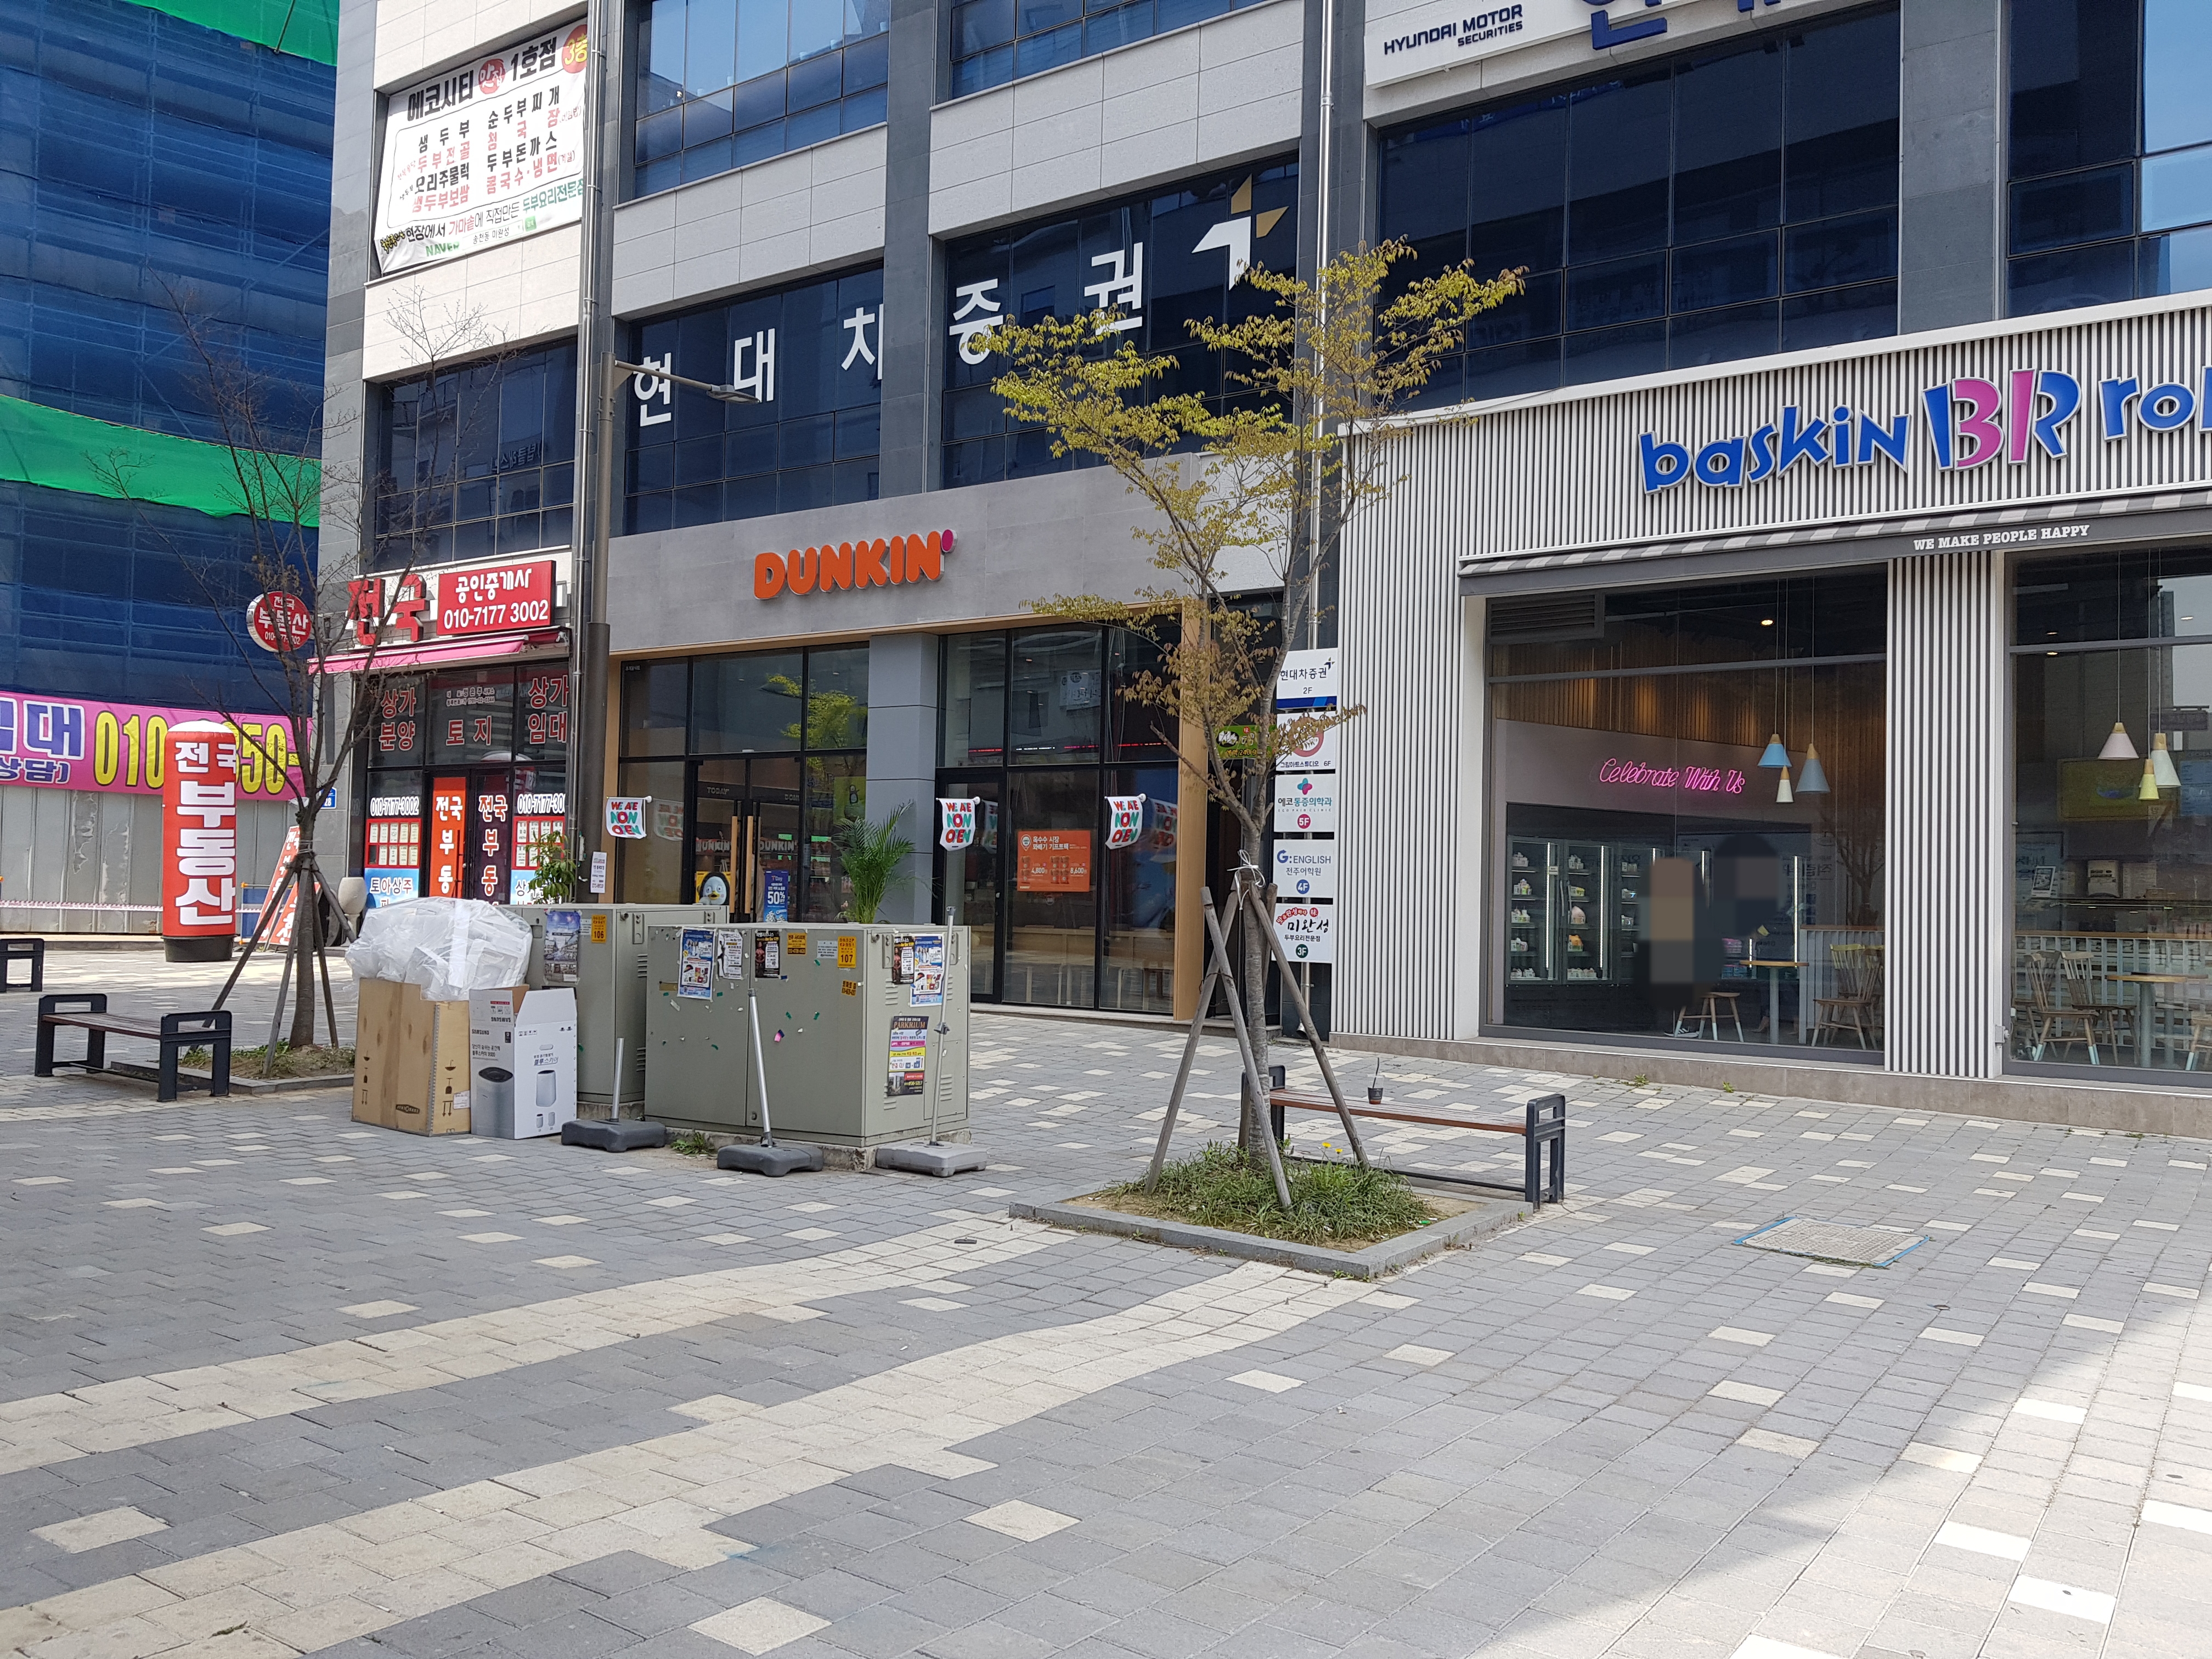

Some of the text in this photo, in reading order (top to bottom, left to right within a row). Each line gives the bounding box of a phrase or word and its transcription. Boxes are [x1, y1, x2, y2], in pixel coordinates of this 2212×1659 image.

[1384, 4, 1523, 55] HYUNDAI MOTOR
[1457, 20, 1523, 47] SECURITIES
[407, 70, 474, 121] 에코시티
[511, 36, 557, 81] 1호점
[415, 162, 469, 194] 오리주물럭
[412, 184, 470, 213] 생두부보쌈
[405, 222, 445, 242] 현장에서
[449, 211, 483, 235] 가마솥에
[486, 201, 520, 224] 직접만든
[425, 241, 460, 257] NAVER
[473, 232, 490, 244] 송천동
[492, 227, 510, 239] 미완성
[2097, 365, 2212, 442] ro
[1913, 524, 2091, 551] WE MAKE PEOPLE HAPPY
[455, 568, 532, 604] 공인중개사
[444, 599, 549, 630] 010-7177 3002
[1280, 668, 1327, 681] 현대차증권
[381, 687, 417, 719] 상가
[528, 674, 569, 709] 상가
[379, 711, 568, 752] 분양 임대
[176, 742, 236, 774] 전국
[1599, 758, 1745, 794] Celebrate With Us
[370, 796, 420, 816] 010-7177-3002
[436, 796, 463, 821] 전국
[478, 795, 507, 822] 전국
[1278, 797, 1332, 807] 에코통증의학과
[610, 811, 638, 824] NOW
[946, 813, 972, 828] NOW
[1114, 811, 1139, 828] NOW
[1299, 817, 1310, 826] 5F
[175, 780, 236, 926] 부동산
[1286, 867, 1321, 876] 전주어학원
[1297, 883, 1308, 891] 4F
[1288, 919, 1329, 933] 미완성
[840, 955, 853, 963] 107
[1297, 947, 1307, 956] 3F
